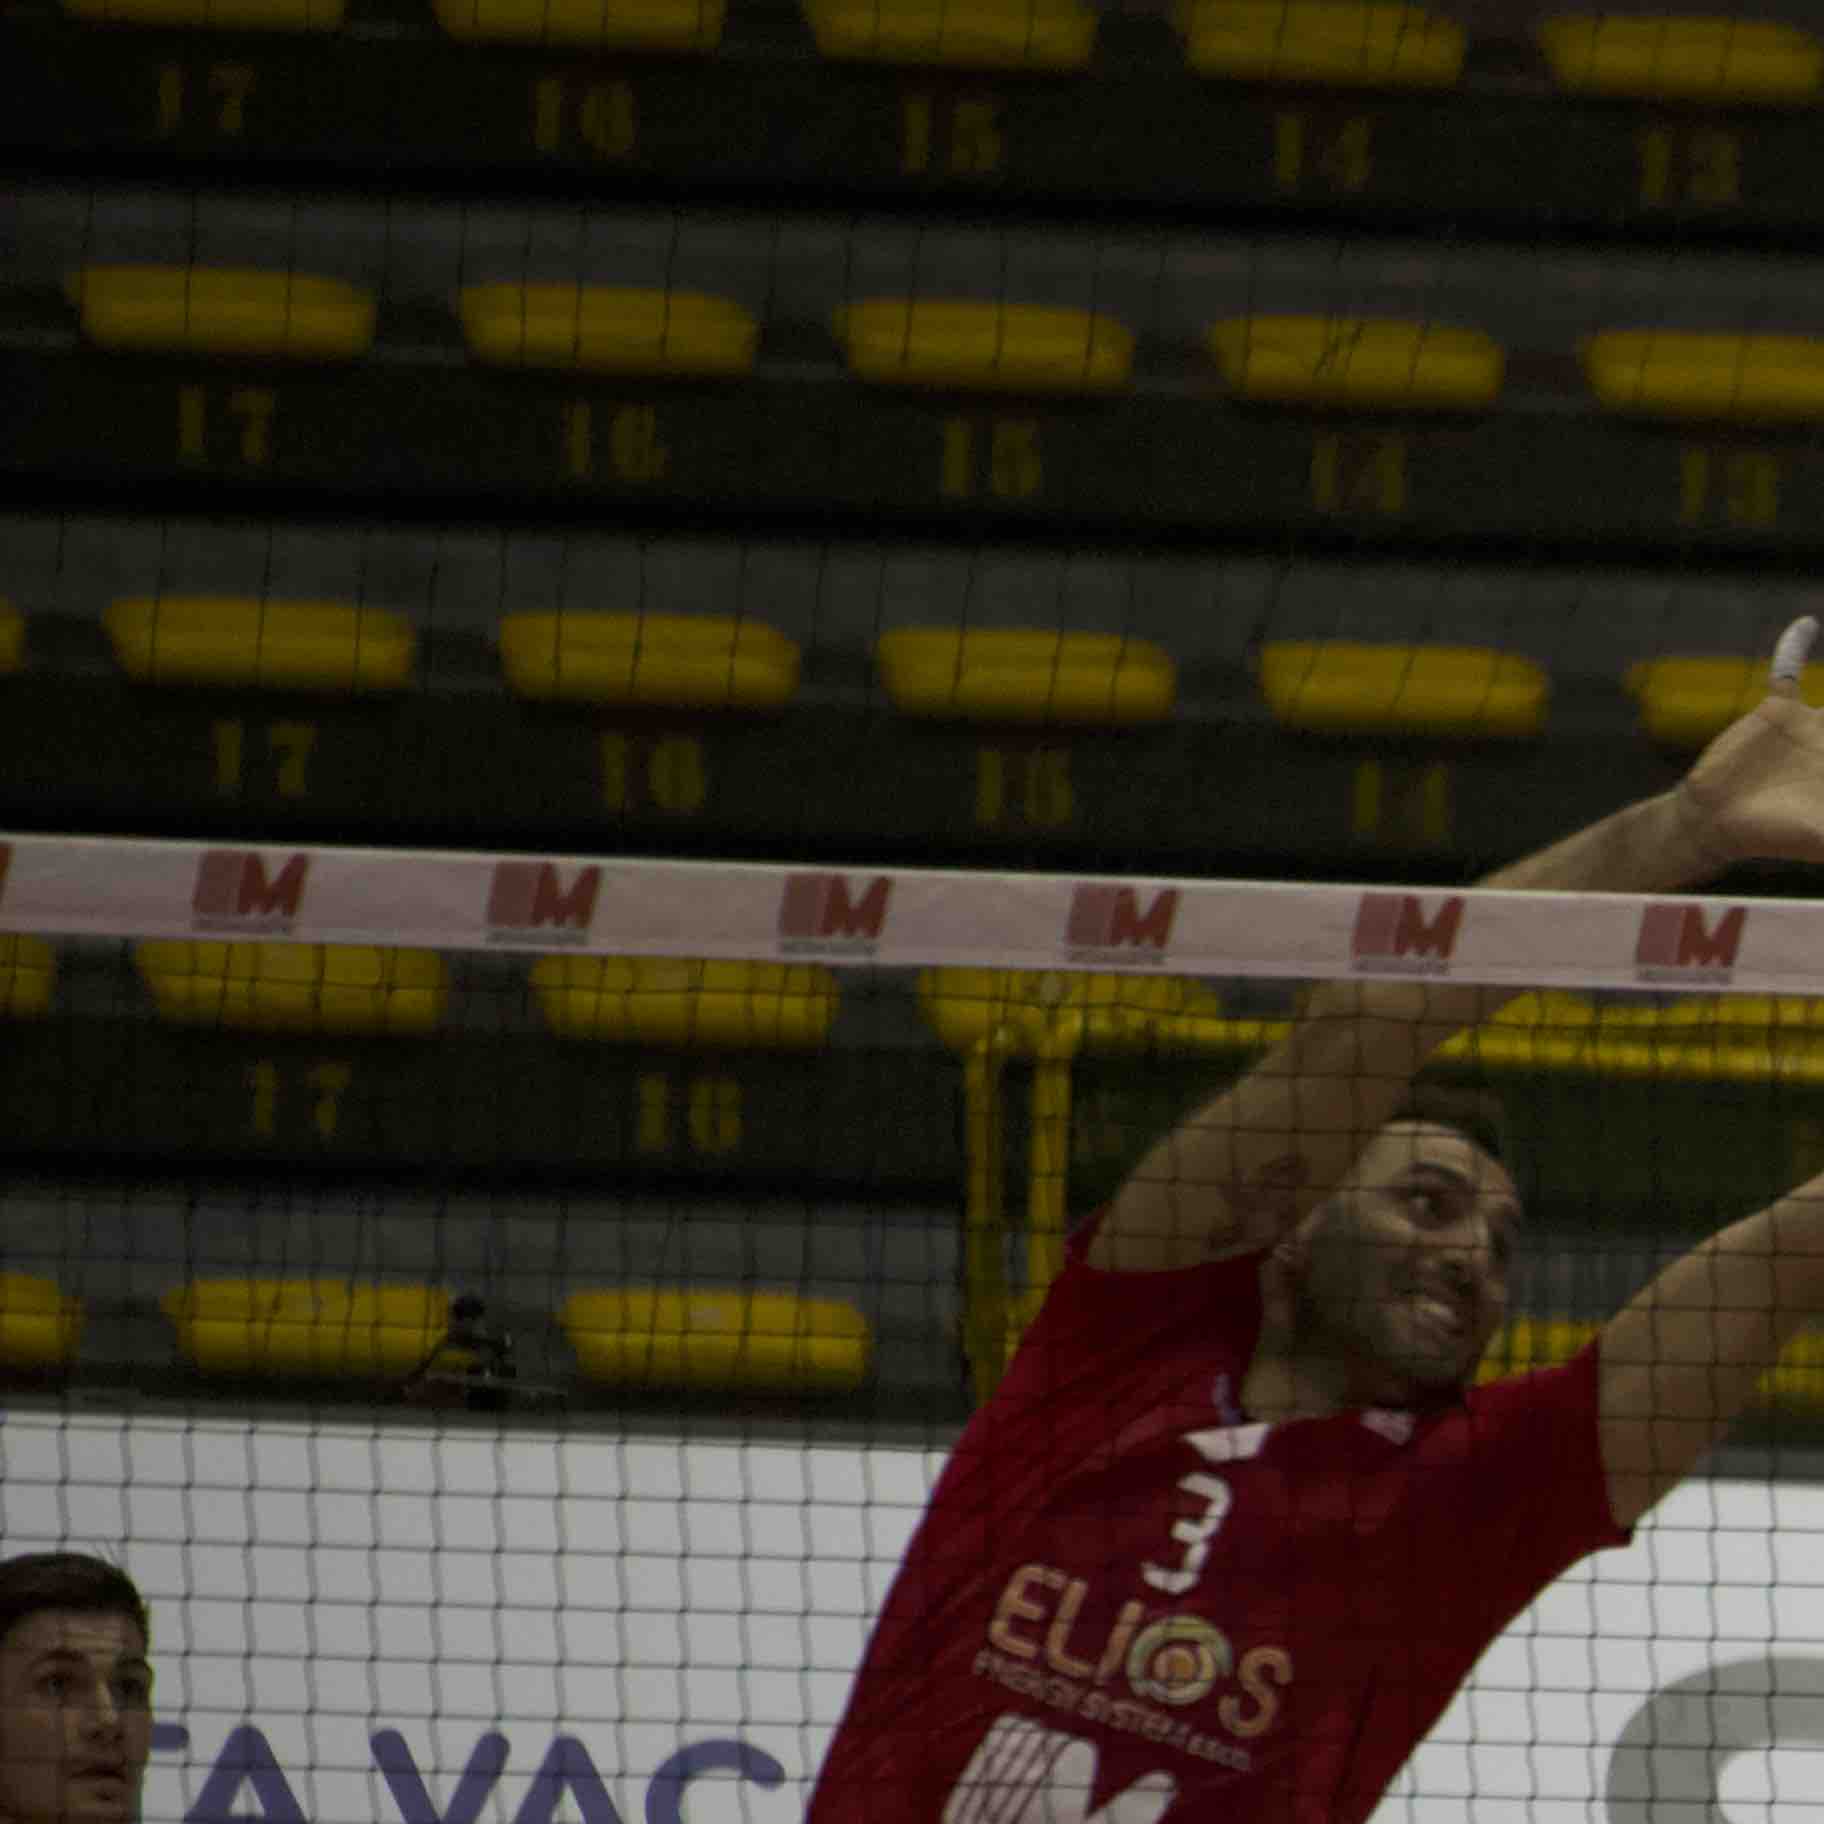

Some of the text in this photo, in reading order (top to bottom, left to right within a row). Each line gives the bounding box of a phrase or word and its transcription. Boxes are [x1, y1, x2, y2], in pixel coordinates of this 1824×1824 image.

[176, 387, 275, 465] 17
[213, 719, 314, 800] 17
[1140, 1471, 1235, 1594] 3
[987, 1562, 1296, 1738] ELIOS
